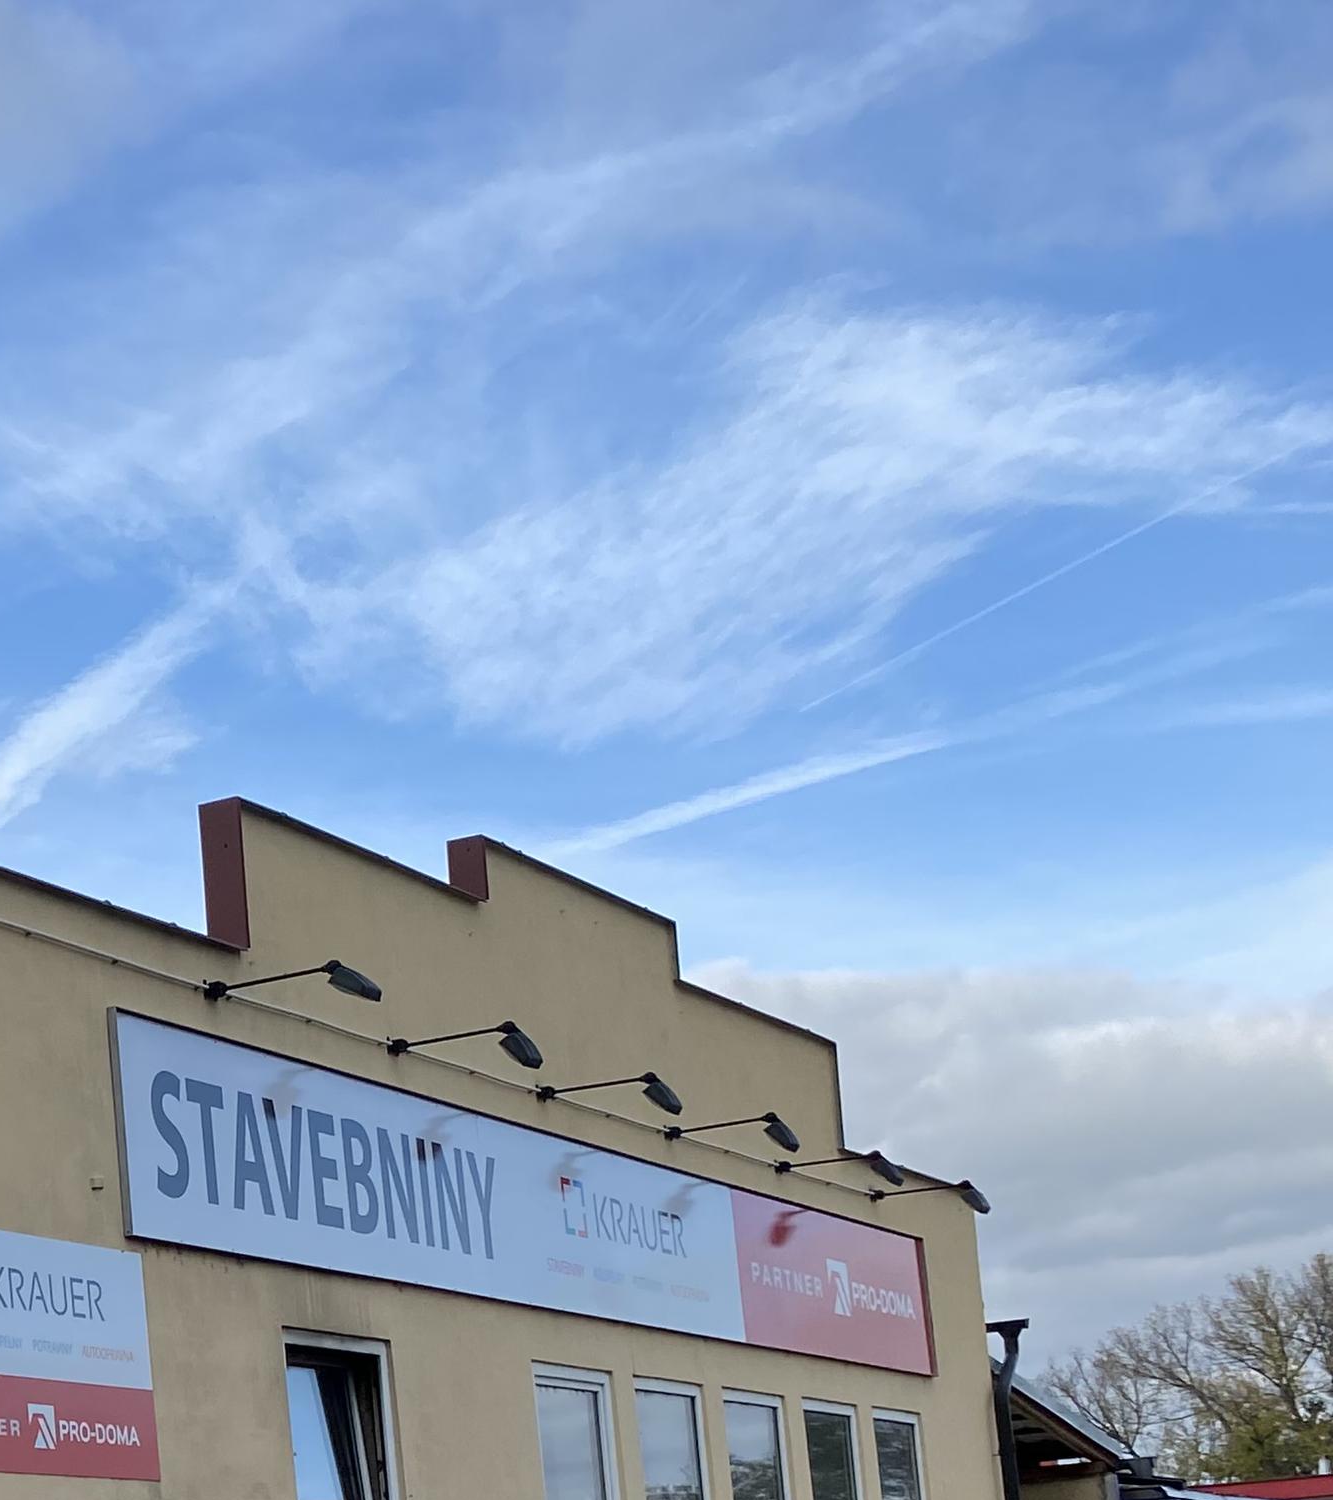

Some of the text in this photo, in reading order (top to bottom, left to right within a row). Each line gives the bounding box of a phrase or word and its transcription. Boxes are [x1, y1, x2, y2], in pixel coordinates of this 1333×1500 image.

[151, 1070, 495, 1260] STAVEBNINY
[592, 1193, 687, 1258] KRAUER
[750, 1261, 824, 1299] PARTNER
[851, 1281, 916, 1320] PRO-DOMA
[58, 1420, 141, 1447] PRO-DOMA
